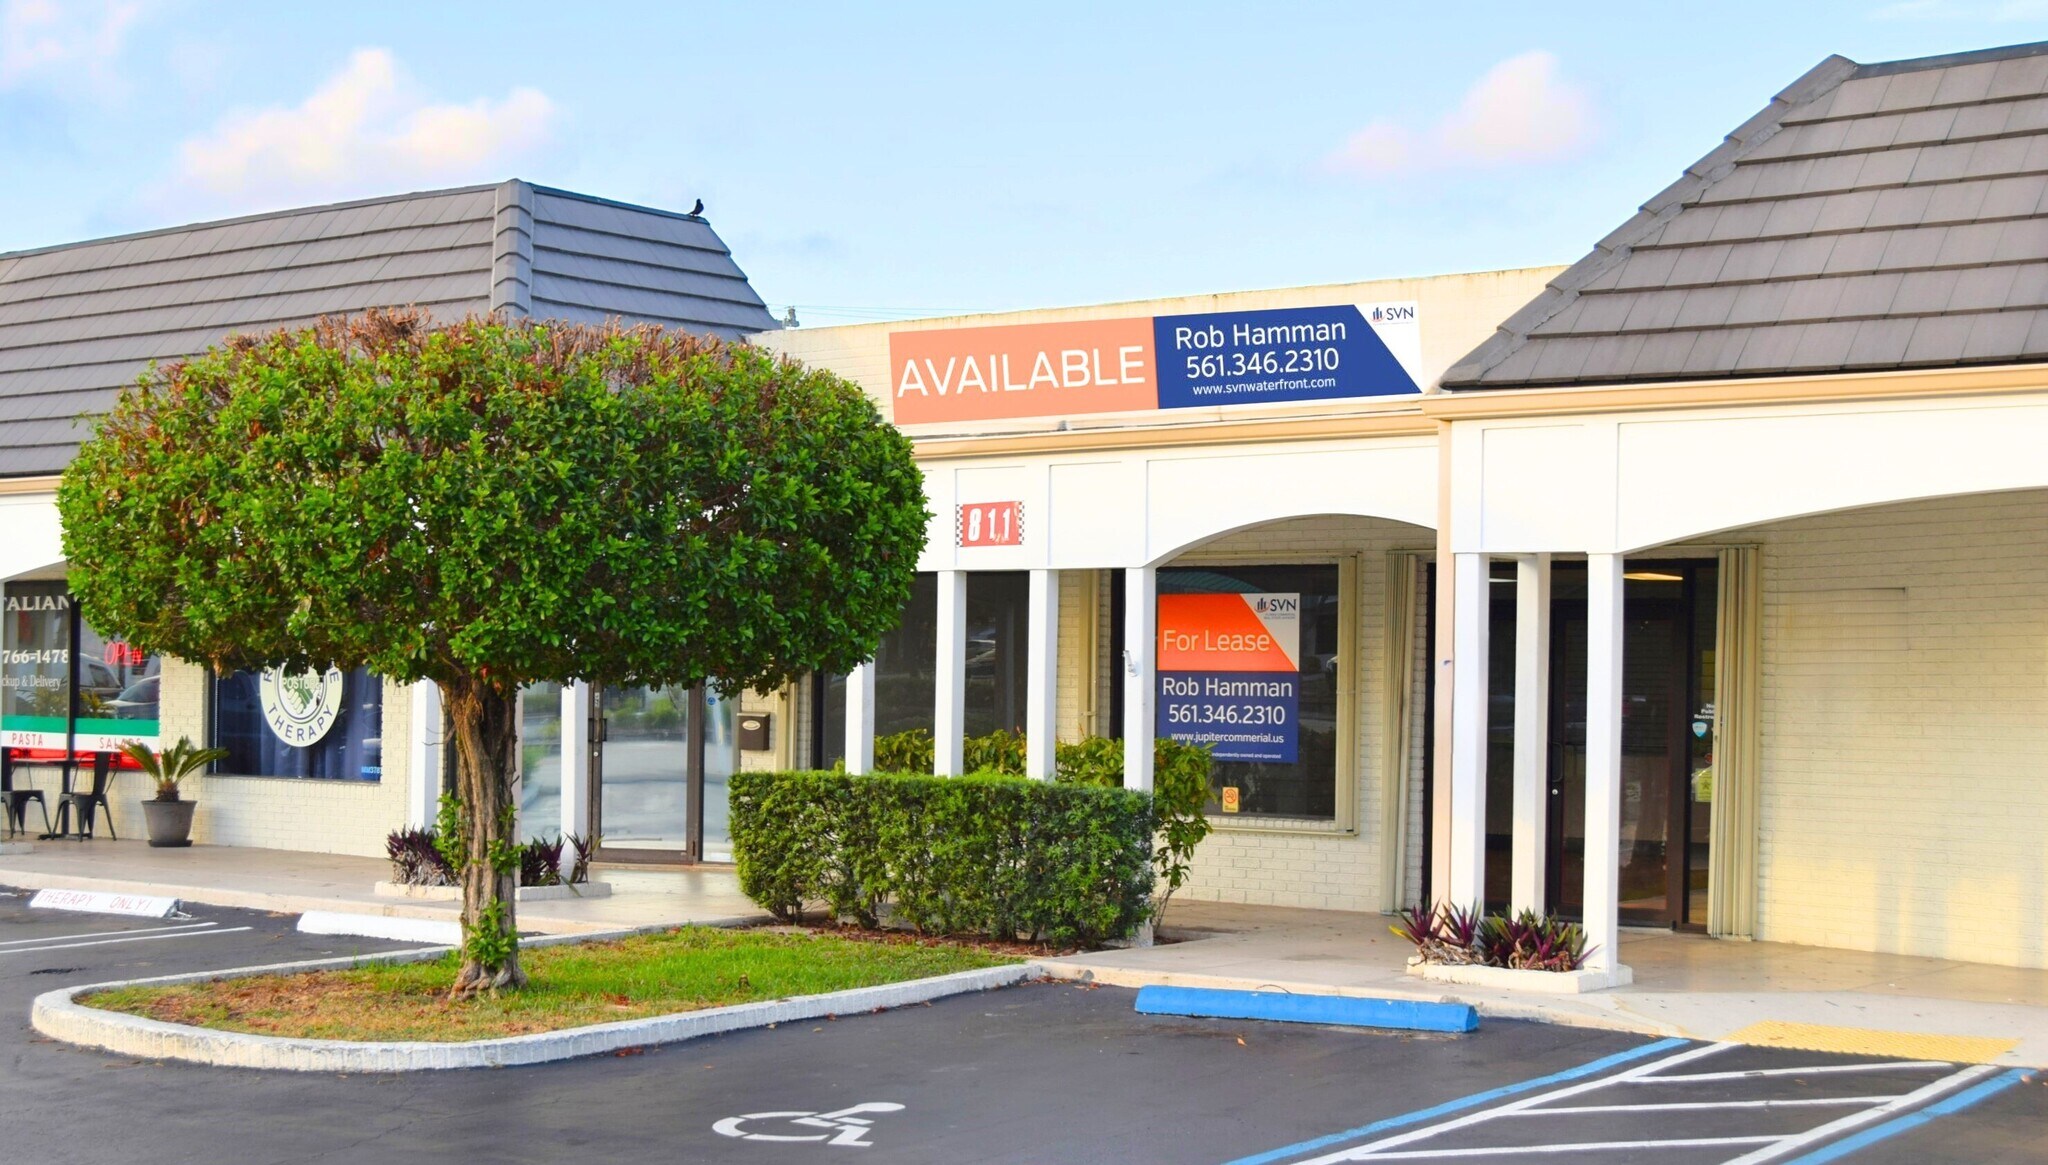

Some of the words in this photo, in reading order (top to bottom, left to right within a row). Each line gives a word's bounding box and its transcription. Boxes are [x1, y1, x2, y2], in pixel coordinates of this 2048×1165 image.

[1386, 306, 1414, 321] SVN
[1175, 324, 1225, 350] Rob
[1233, 322, 1346, 346] Hamman
[897, 345, 1146, 398] AVAILABLE
[1186, 347, 1340, 379] 561.346.2310
[1193, 377, 1336, 395] www.svnwaterfront.com
[968, 507, 1011, 542] 811
[3, 595, 70, 611] ALIAN
[1270, 598, 1297, 612] SVN
[1163, 629, 1199, 652] For
[1204, 629, 1270, 652] Lease
[22, 675, 27, 687] &
[30, 674, 62, 691] Delivery
[1162, 677, 1199, 696] Rob
[1205, 678, 1293, 698] Hamman
[268, 703, 333, 742] THERAPY
[1168, 704, 1286, 725] 561.346.2310
[11, 732, 44, 746] PASTA
[37, 890, 97, 907] THERAPY
